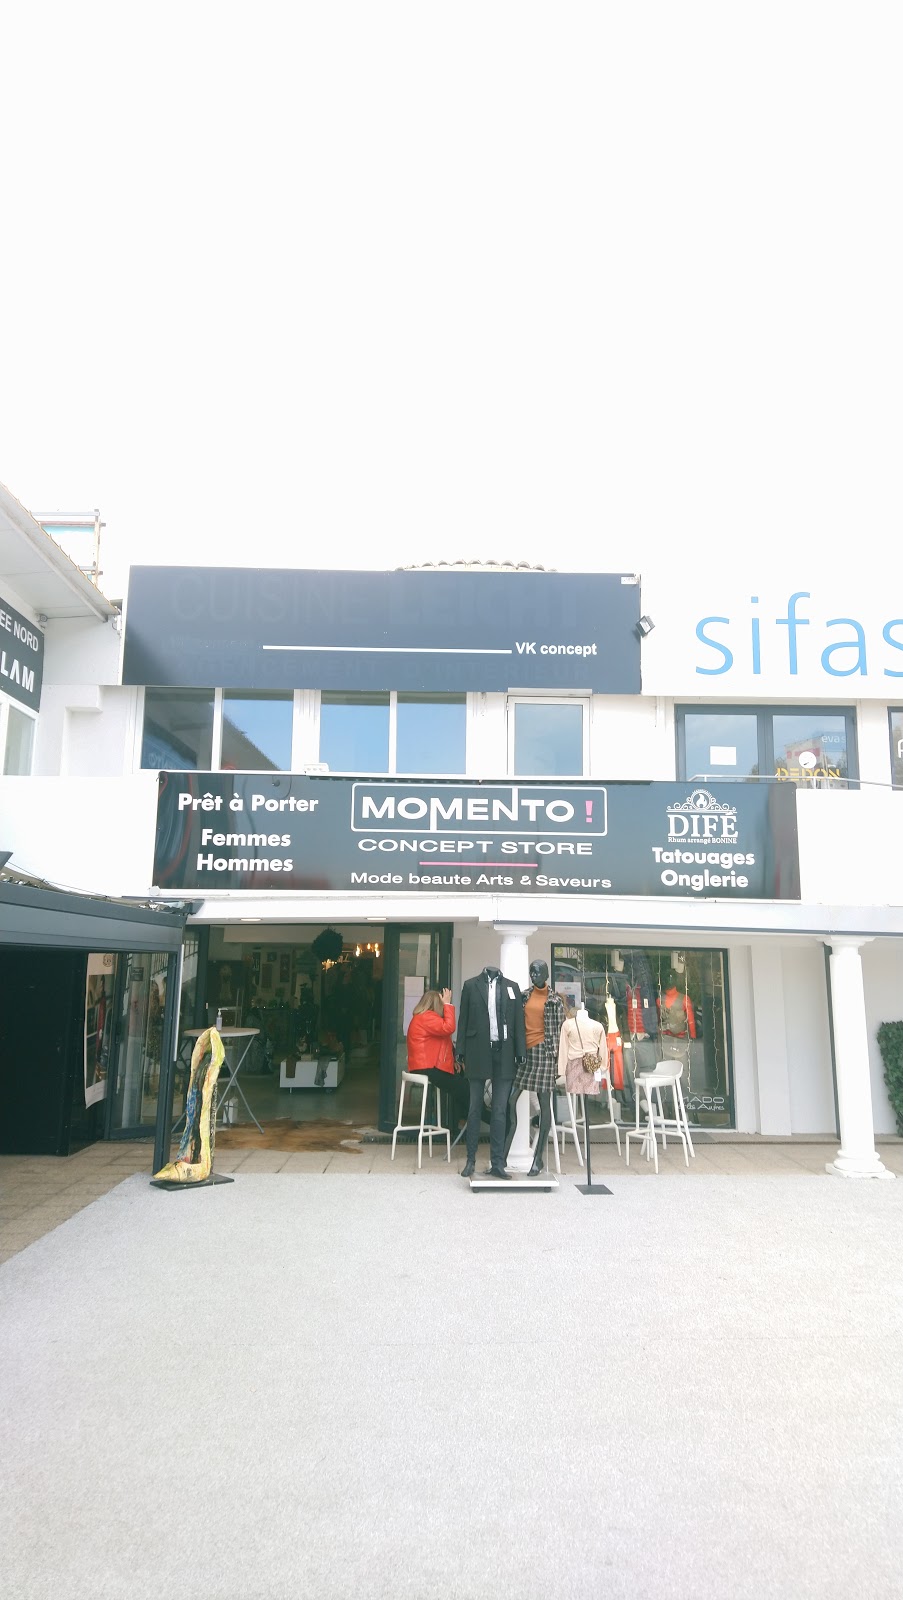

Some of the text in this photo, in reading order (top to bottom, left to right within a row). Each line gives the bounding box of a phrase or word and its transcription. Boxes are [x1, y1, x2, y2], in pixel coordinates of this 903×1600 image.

[13, 620, 39, 652] NORD
[695, 592, 903, 677] sifas
[515, 642, 598, 657] VK concept
[178, 792, 319, 812] Prêt à Porter
[361, 792, 575, 827] MOMENTO
[667, 811, 739, 838] DIFÉ
[201, 828, 292, 847] Femmes
[357, 839, 593, 855] CONCEPT STORE
[196, 853, 294, 872] Hommes
[651, 847, 756, 869] Tatouages
[350, 872, 612, 888] Mode beaute Arts & Saveurs
[660, 869, 749, 891] Onglerie
